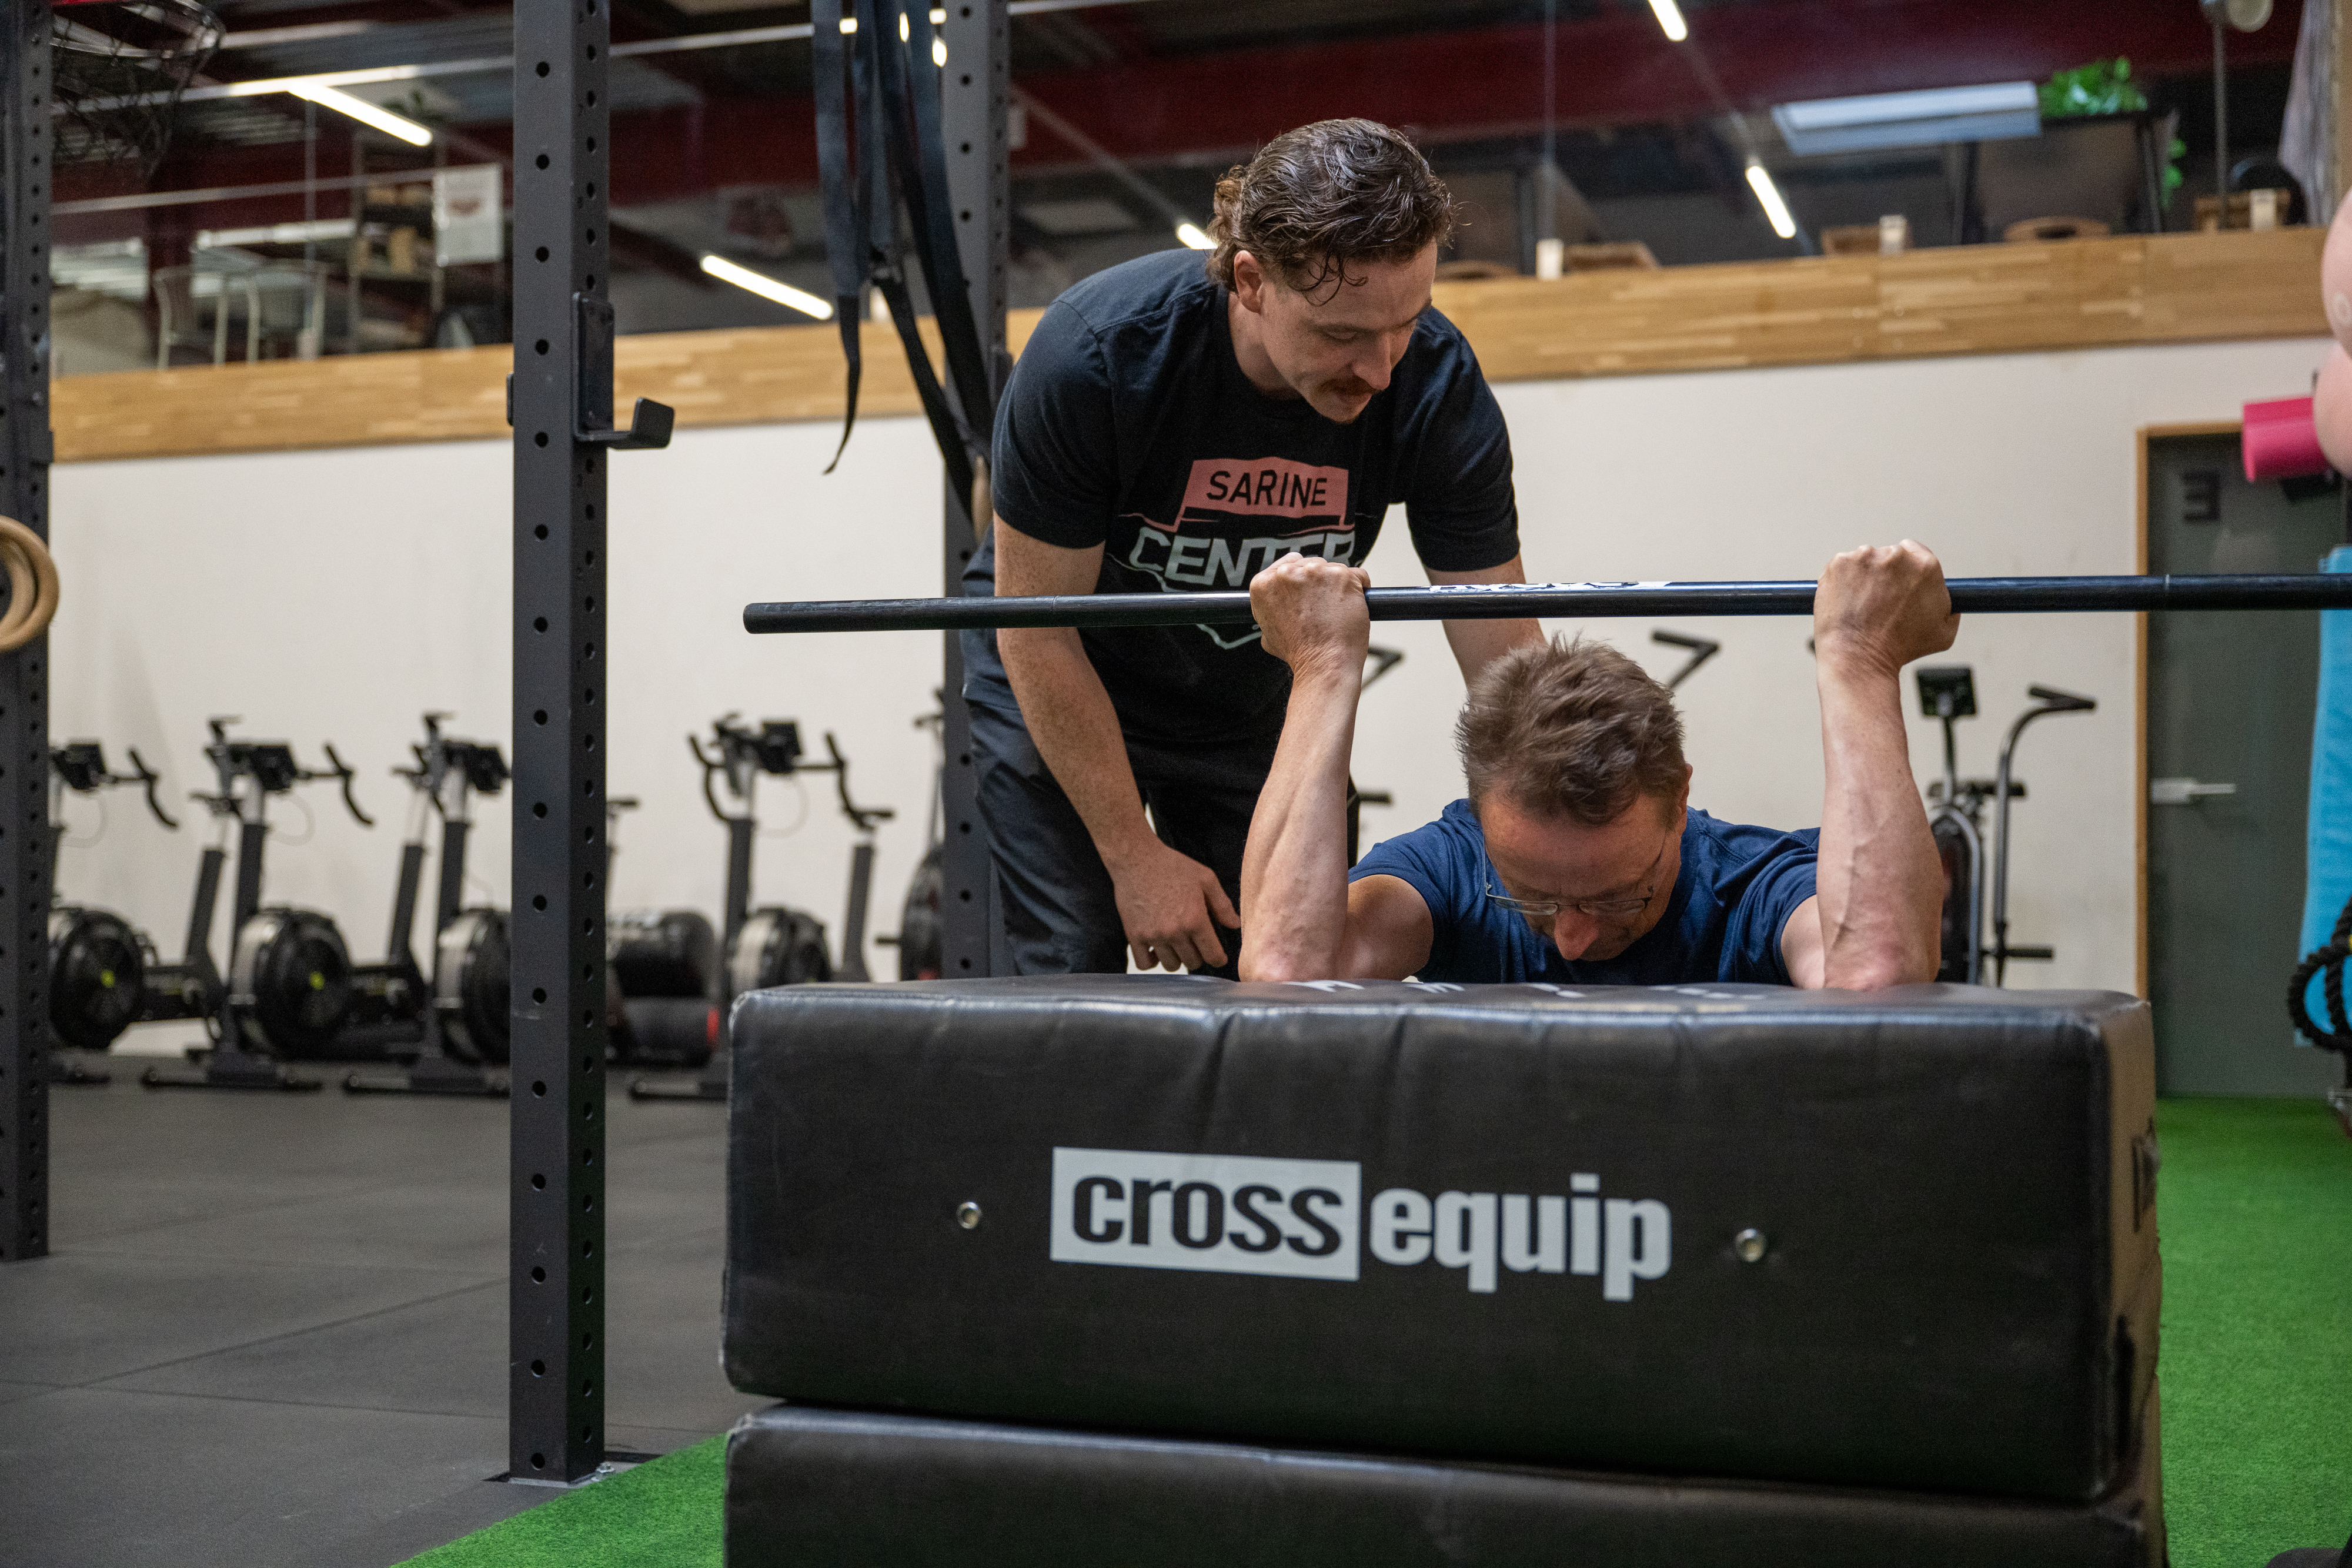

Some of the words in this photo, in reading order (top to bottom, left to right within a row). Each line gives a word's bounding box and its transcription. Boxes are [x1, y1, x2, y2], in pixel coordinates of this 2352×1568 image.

[1206, 469, 1328, 509] SARINE
[1071, 1175, 1344, 1259] cross
[1369, 1172, 1672, 1302] equip
